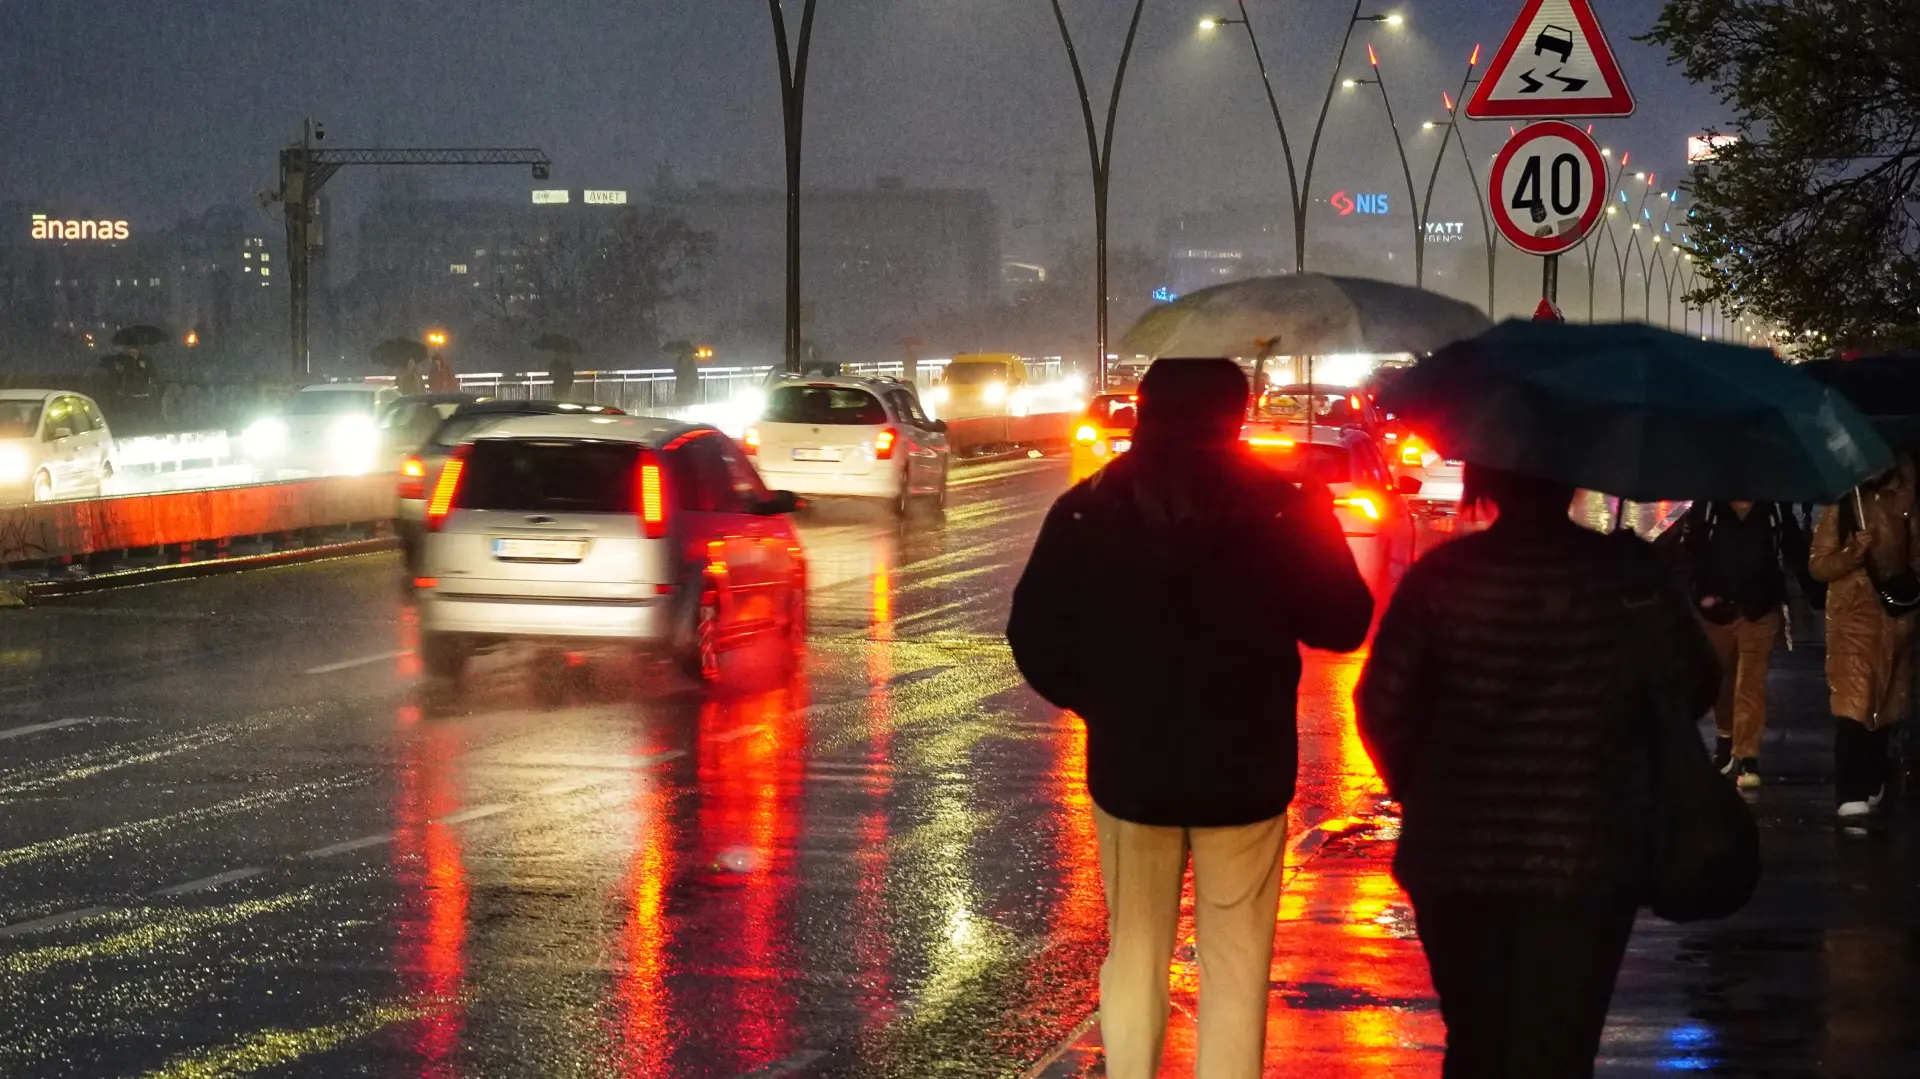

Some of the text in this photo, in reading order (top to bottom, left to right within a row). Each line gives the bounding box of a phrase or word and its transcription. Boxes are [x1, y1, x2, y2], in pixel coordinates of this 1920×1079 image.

[1512, 153, 1580, 215] 40
[1356, 193, 1388, 214] NIS
[1419, 222, 1464, 234] YATT
